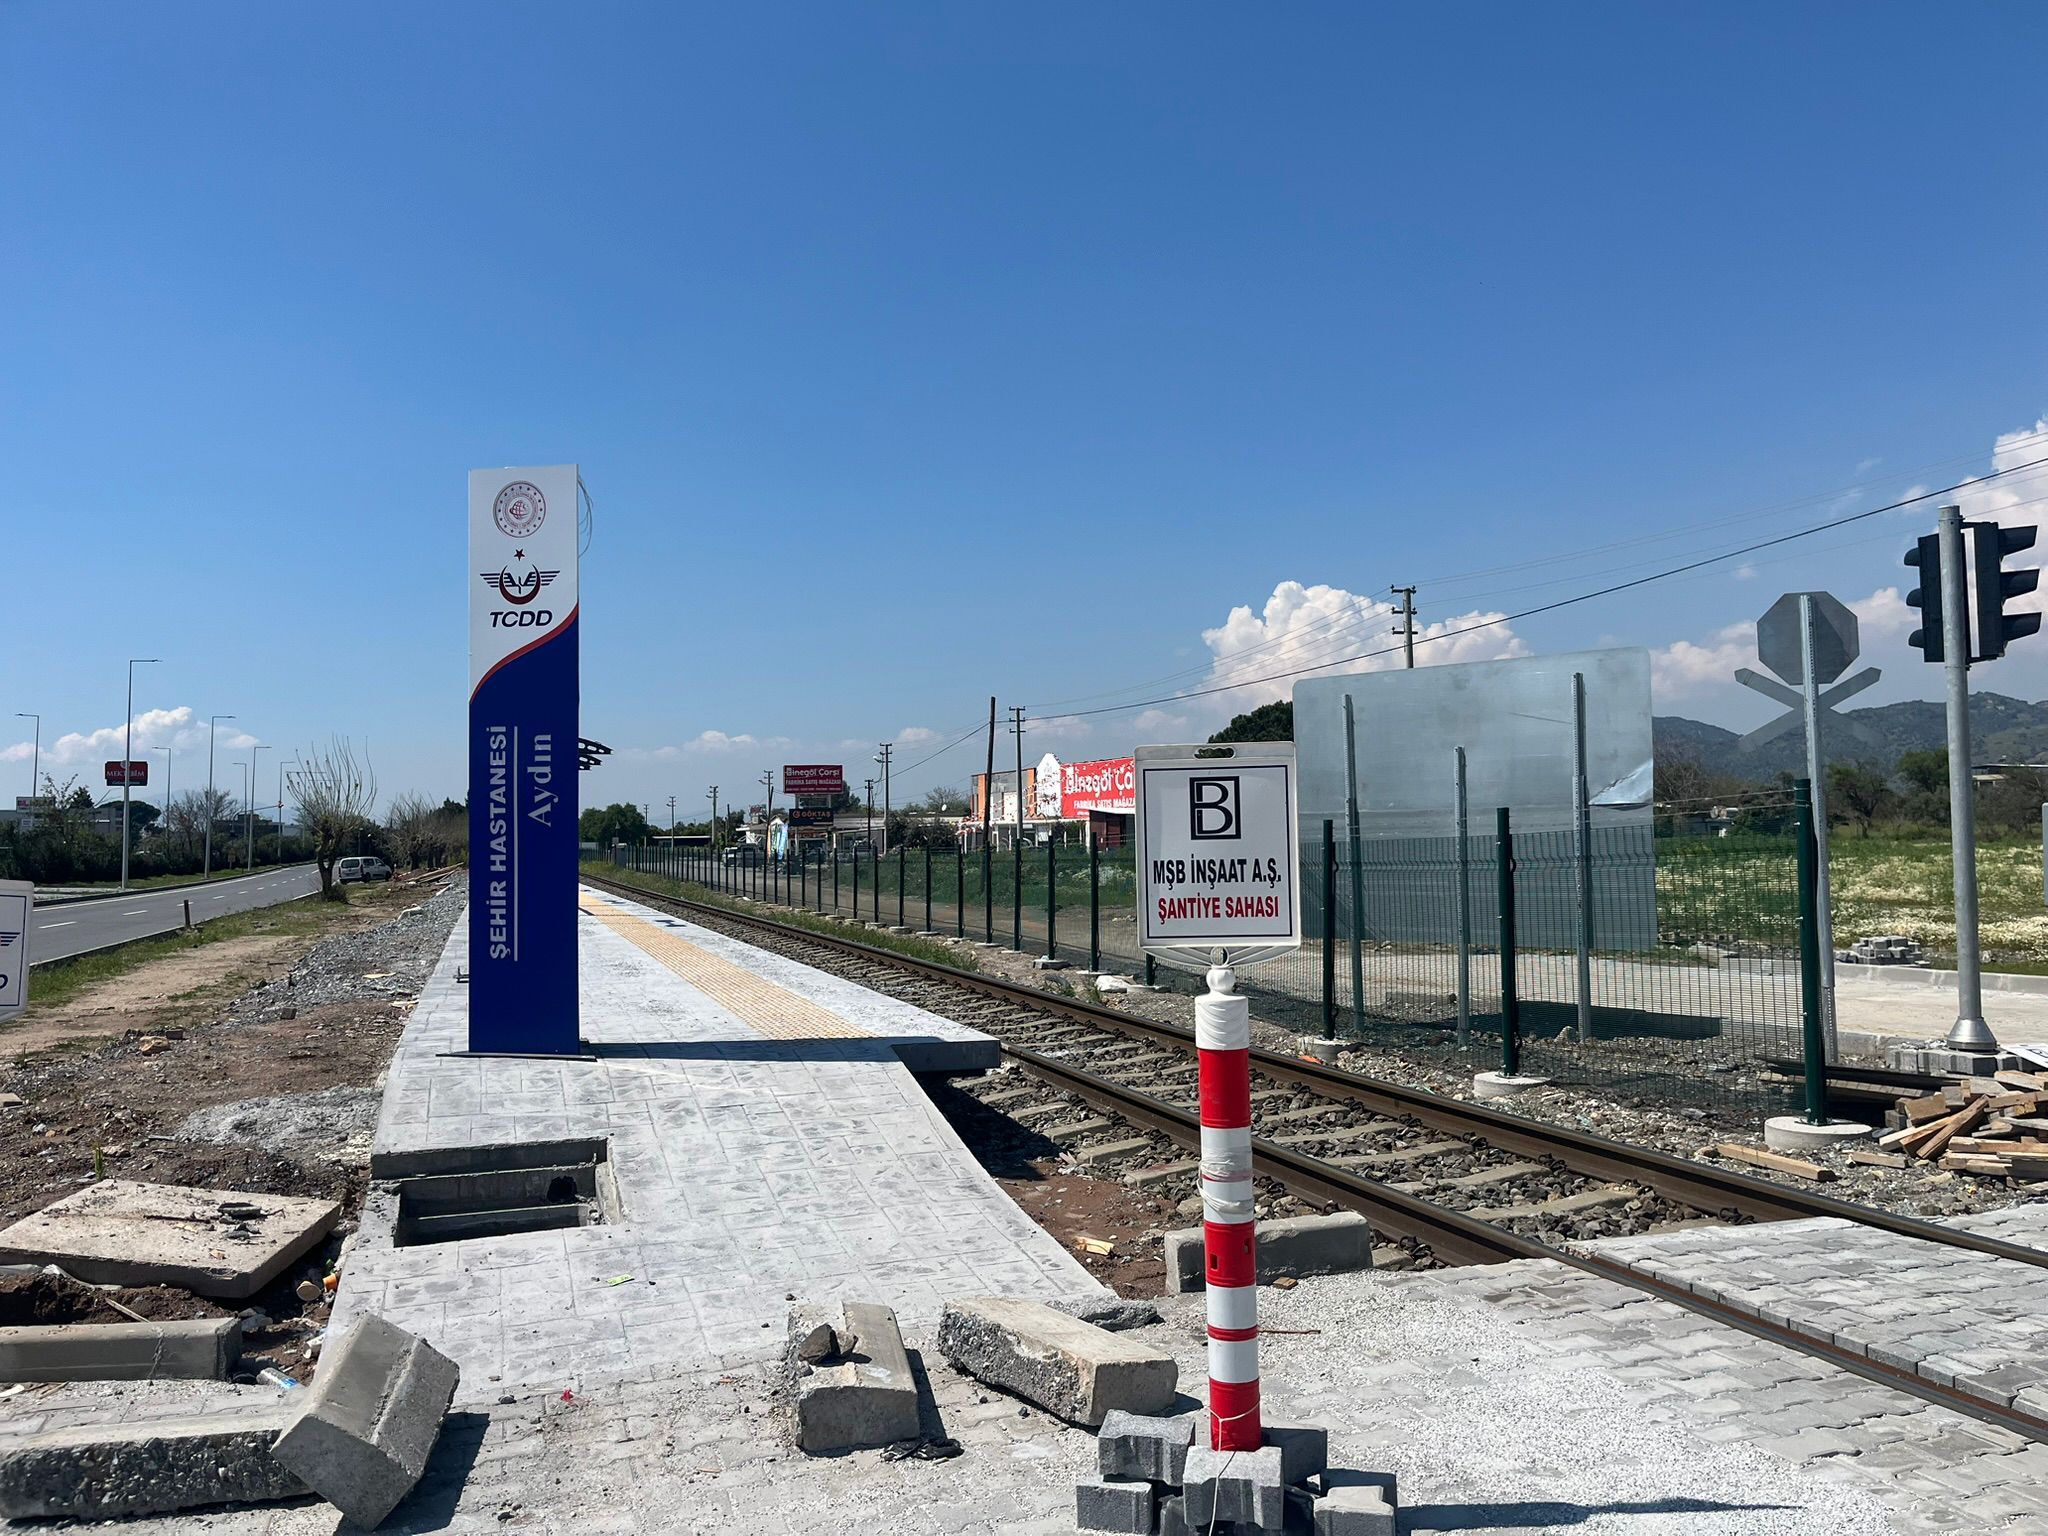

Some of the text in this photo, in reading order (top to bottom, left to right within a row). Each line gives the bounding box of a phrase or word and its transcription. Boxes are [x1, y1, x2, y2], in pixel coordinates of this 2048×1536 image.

[490, 610, 552, 627] TCDD
[528, 734, 558, 827] Aydın
[1196, 782, 1233, 834] B
[487, 726, 510, 959] ŞEHİR HASTANESİ
[1153, 854, 1281, 890] MŞB İNŞAAT A.Ş.
[1158, 893, 1279, 925] ŞANTİYE SAHASI
